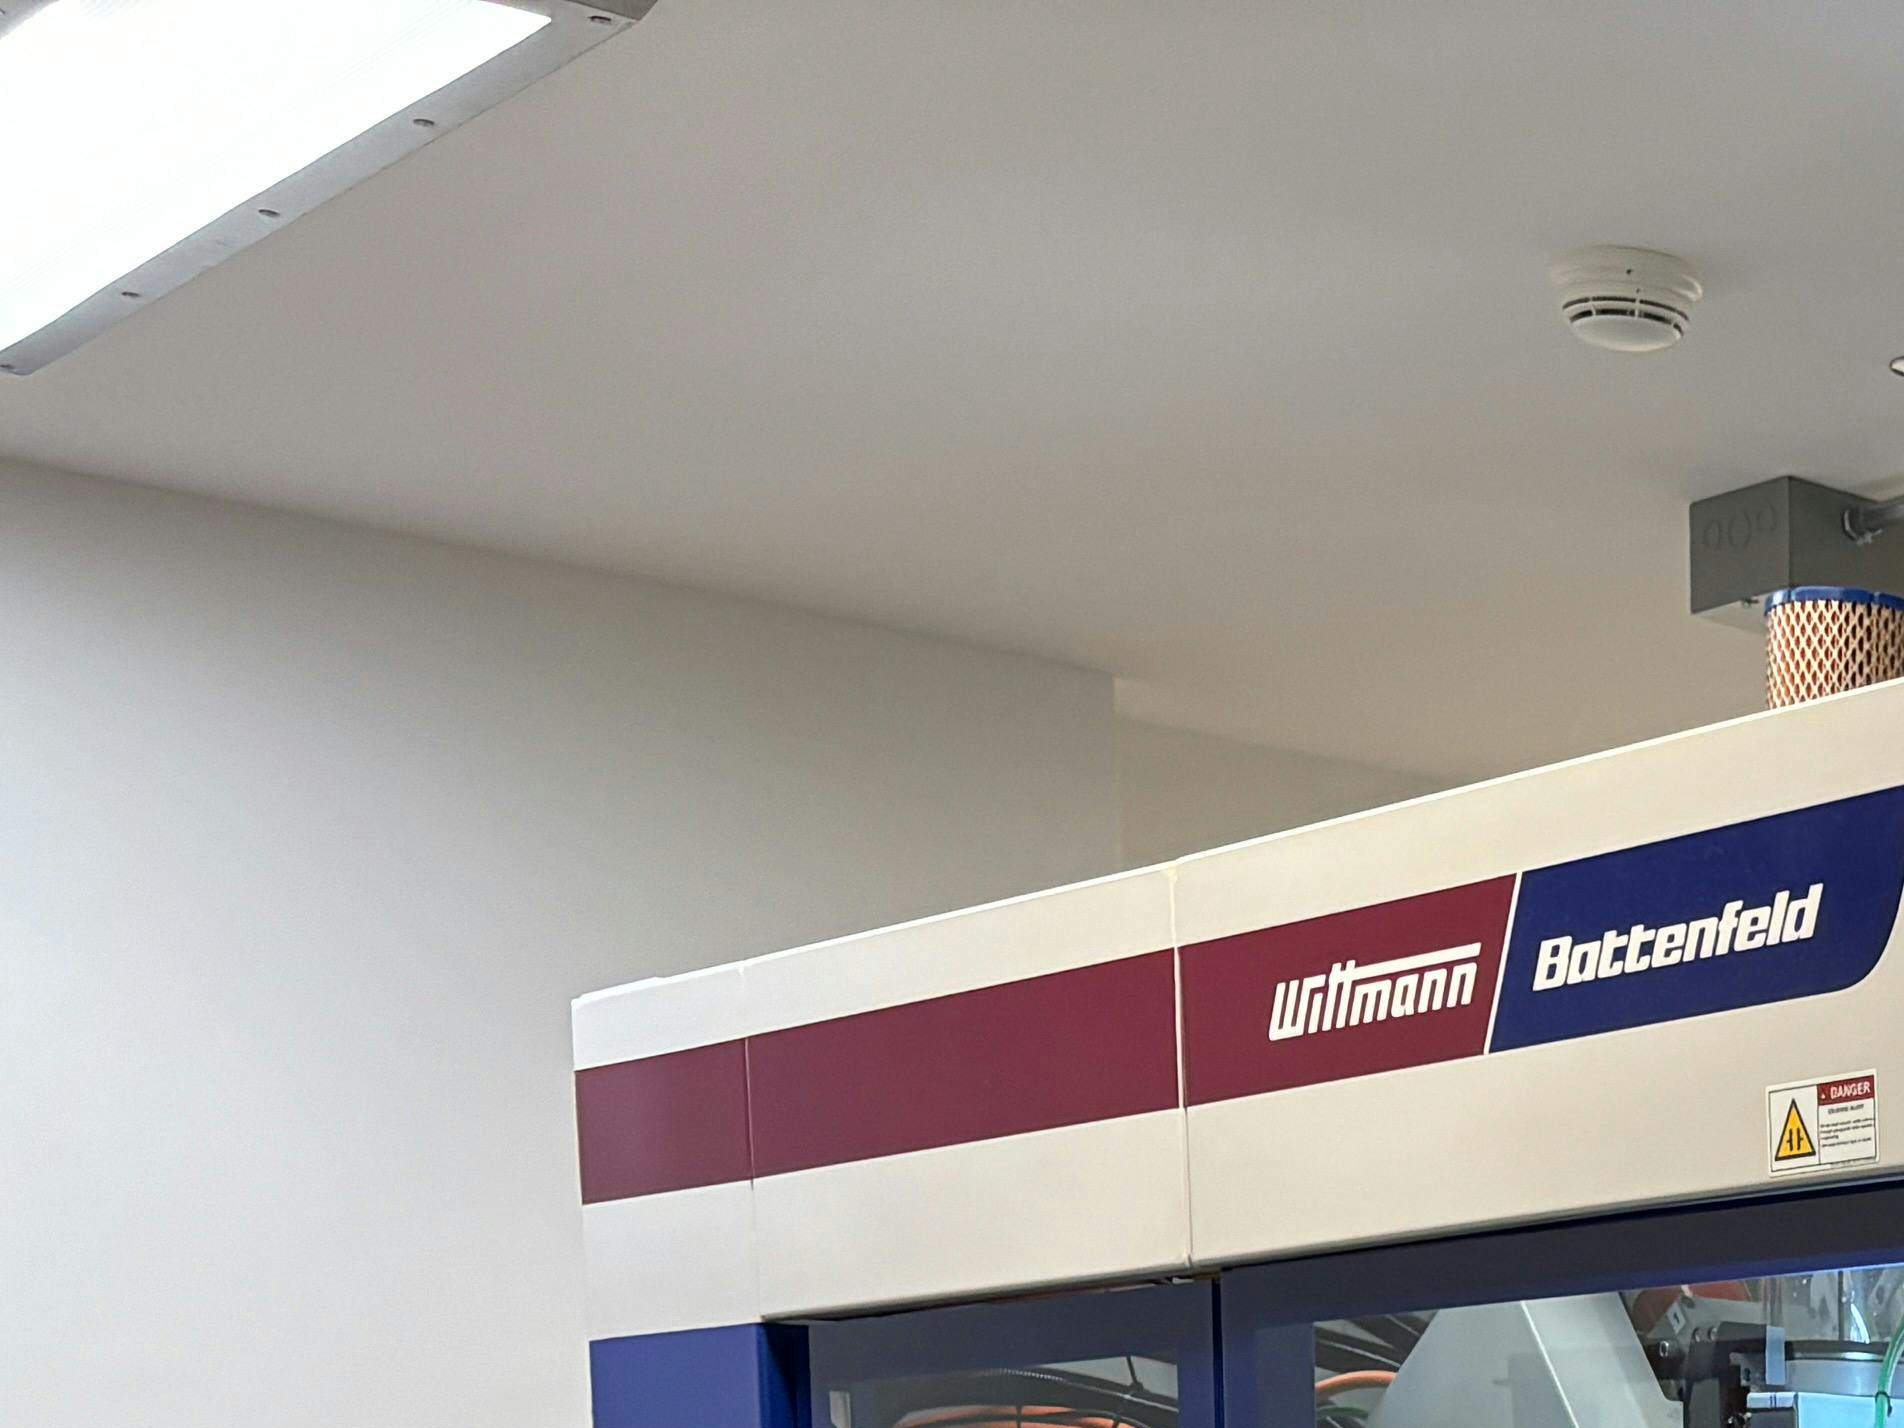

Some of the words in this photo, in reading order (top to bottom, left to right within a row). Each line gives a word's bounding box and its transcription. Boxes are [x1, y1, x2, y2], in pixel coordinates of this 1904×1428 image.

[1268, 942, 1482, 1041] Wittmann
[1532, 882, 1824, 992] Battenfeld
[1830, 1081, 1871, 1099] DANGER
